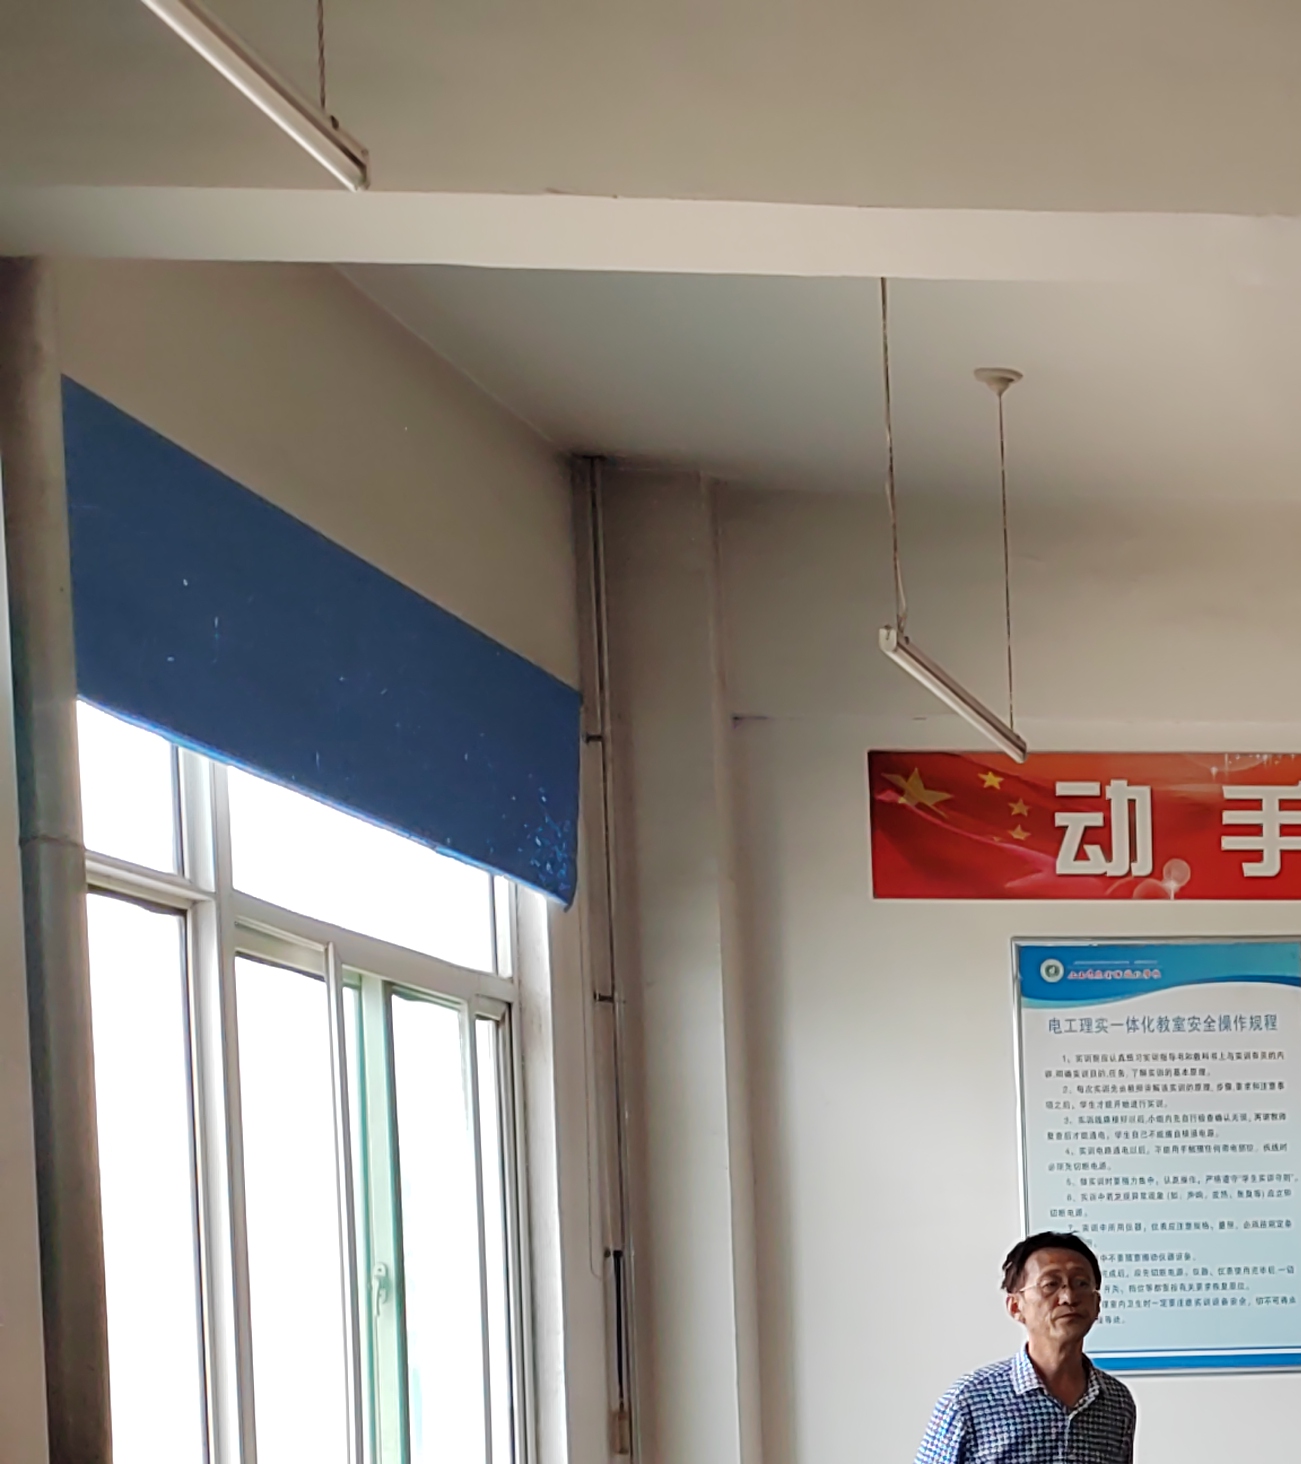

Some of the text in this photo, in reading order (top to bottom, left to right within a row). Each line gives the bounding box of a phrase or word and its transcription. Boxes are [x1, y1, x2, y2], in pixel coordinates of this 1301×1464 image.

[1049, 1013, 1278, 1035] 电工理实一体化教室安全操作规程
